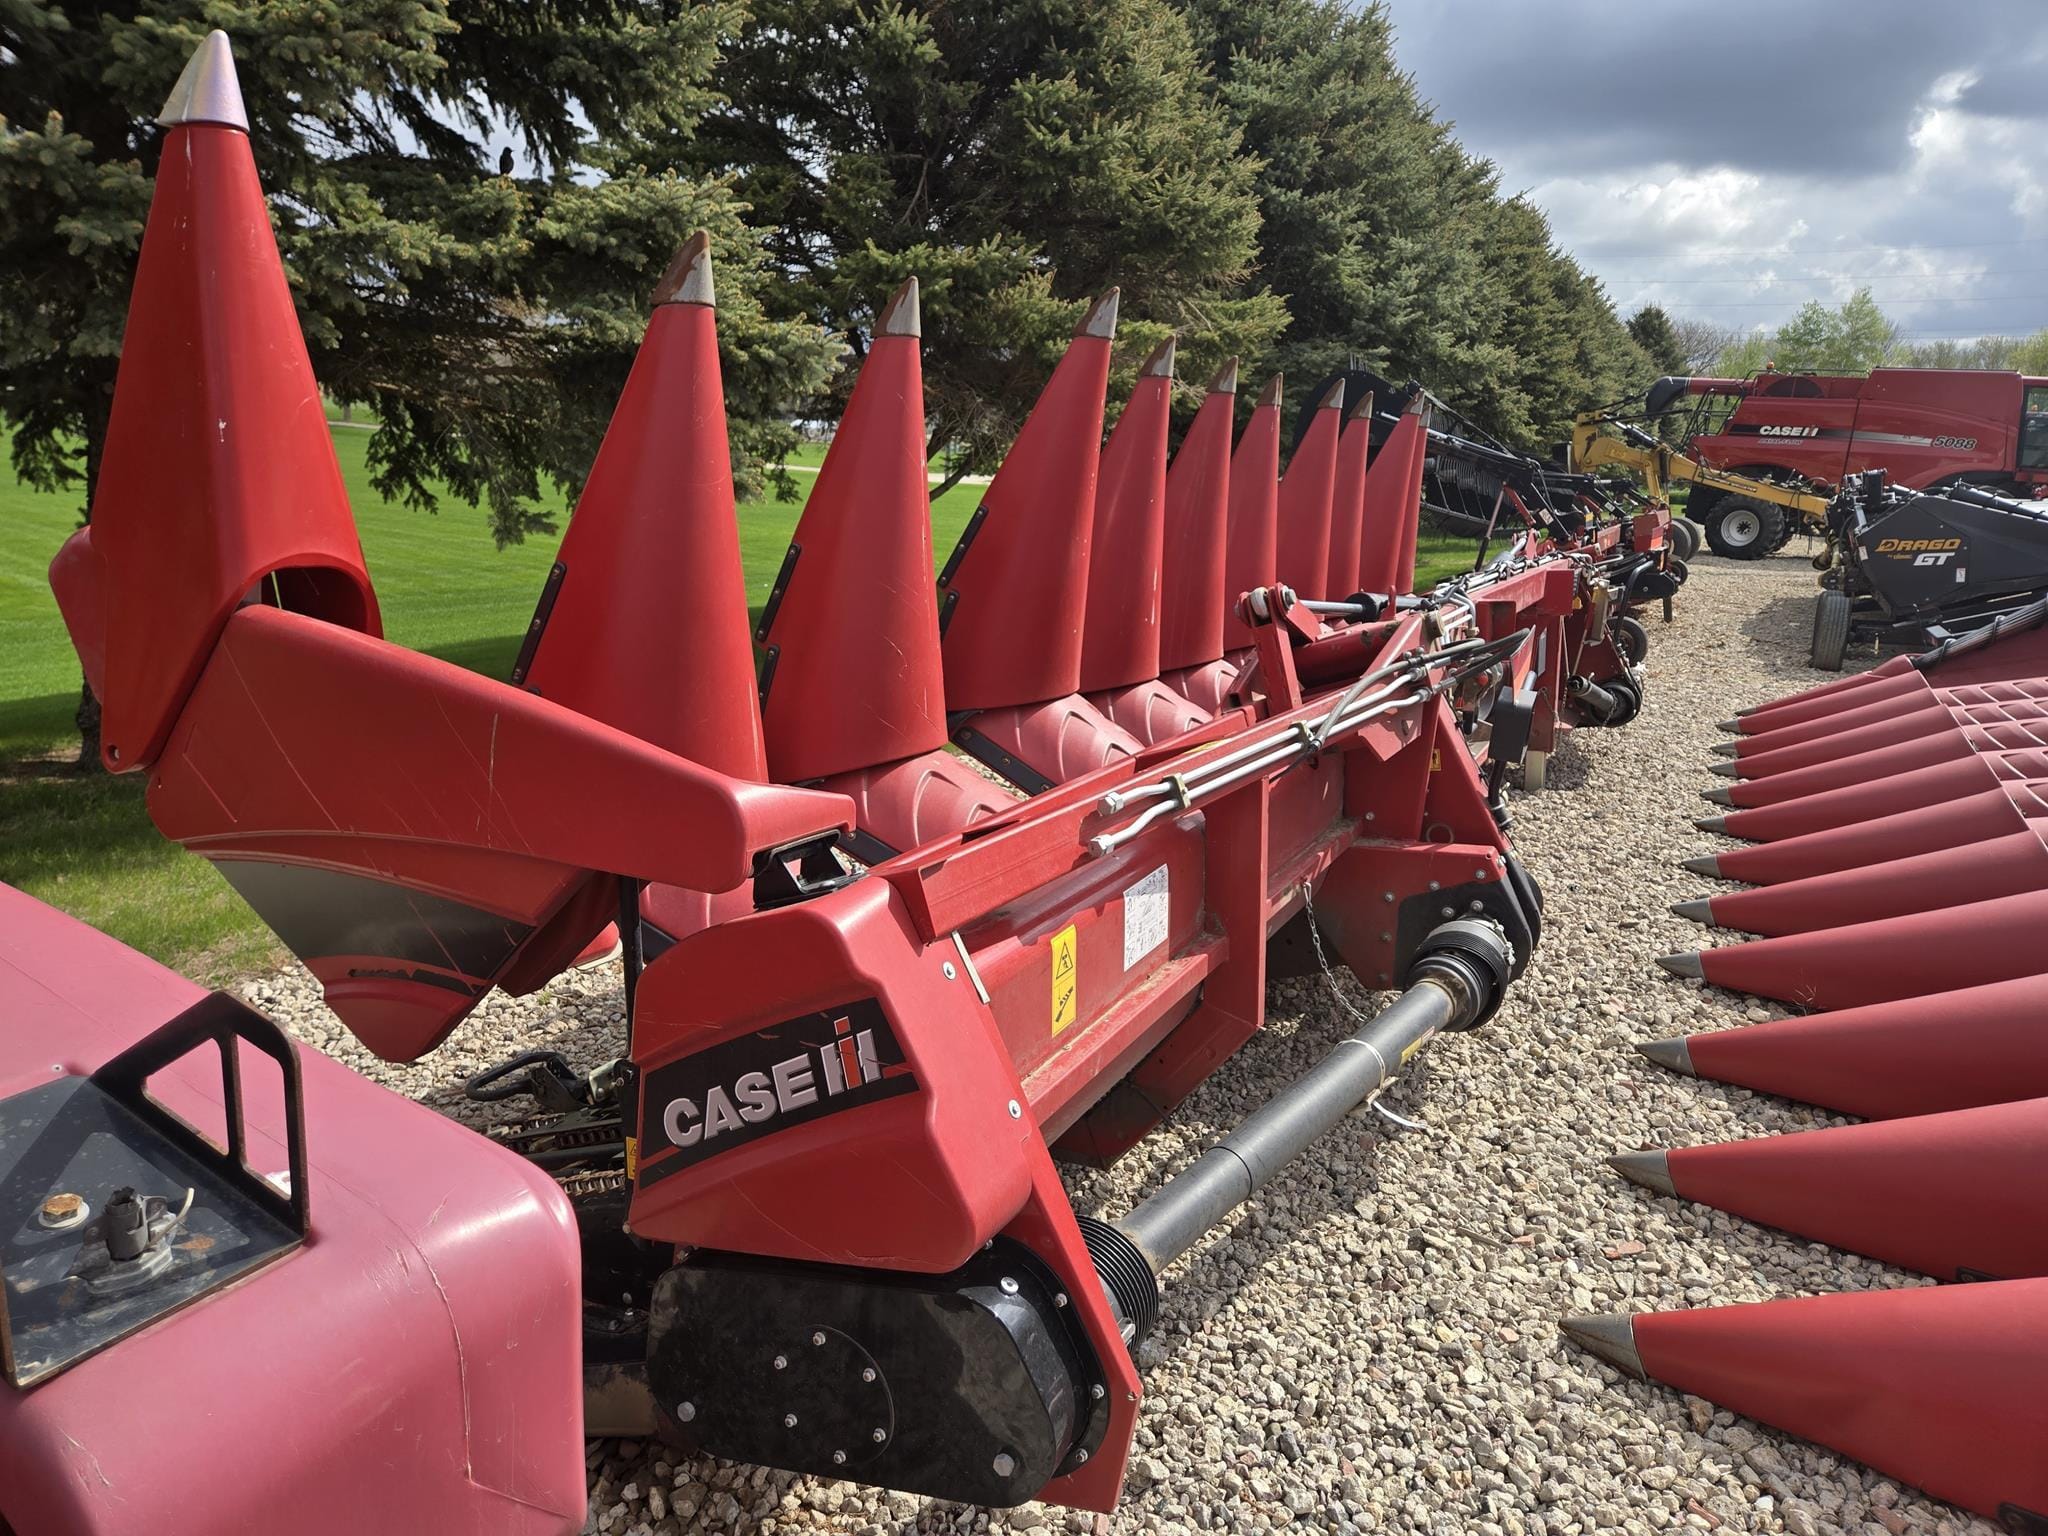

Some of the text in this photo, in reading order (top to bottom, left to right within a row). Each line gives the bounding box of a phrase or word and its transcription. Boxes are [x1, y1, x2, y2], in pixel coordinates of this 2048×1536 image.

[1760, 425, 1803, 436] CASE
[1933, 436, 1978, 450] 5088
[1875, 538, 1962, 553] DRAGO
[1913, 552, 1956, 566] GT
[663, 1052, 818, 1149] CASE
